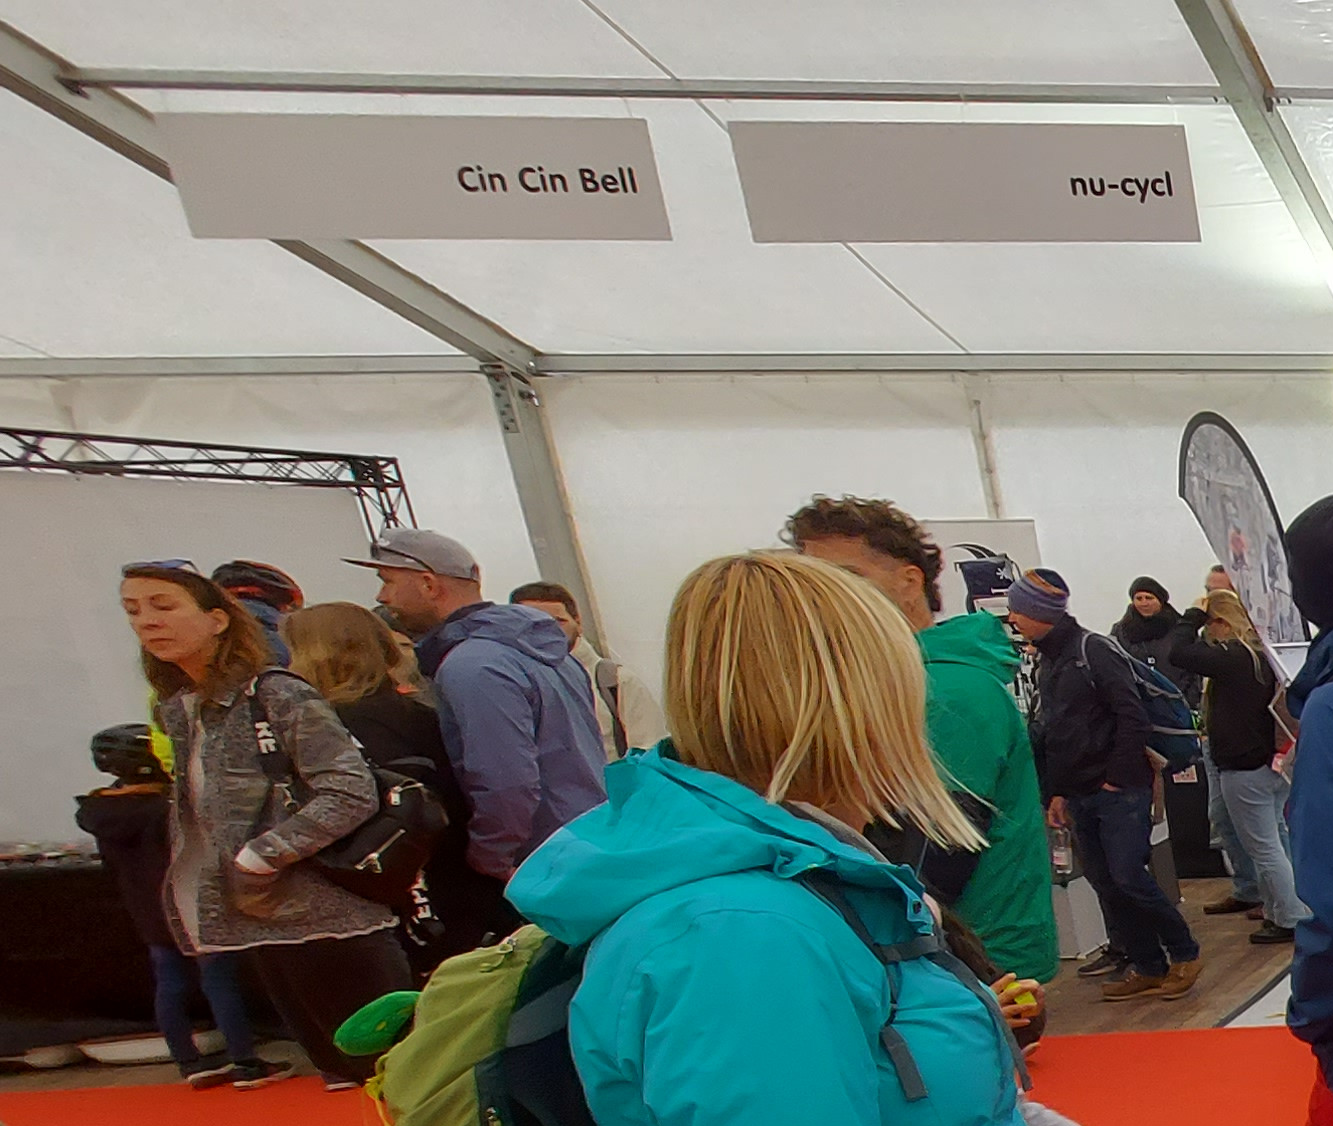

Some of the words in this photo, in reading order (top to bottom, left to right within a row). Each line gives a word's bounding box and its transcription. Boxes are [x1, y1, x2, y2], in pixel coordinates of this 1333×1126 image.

[457, 165, 508, 193] Cin
[518, 165, 569, 193] Cin
[578, 167, 638, 194] Bell
[1069, 171, 1173, 204] nu-cycl
